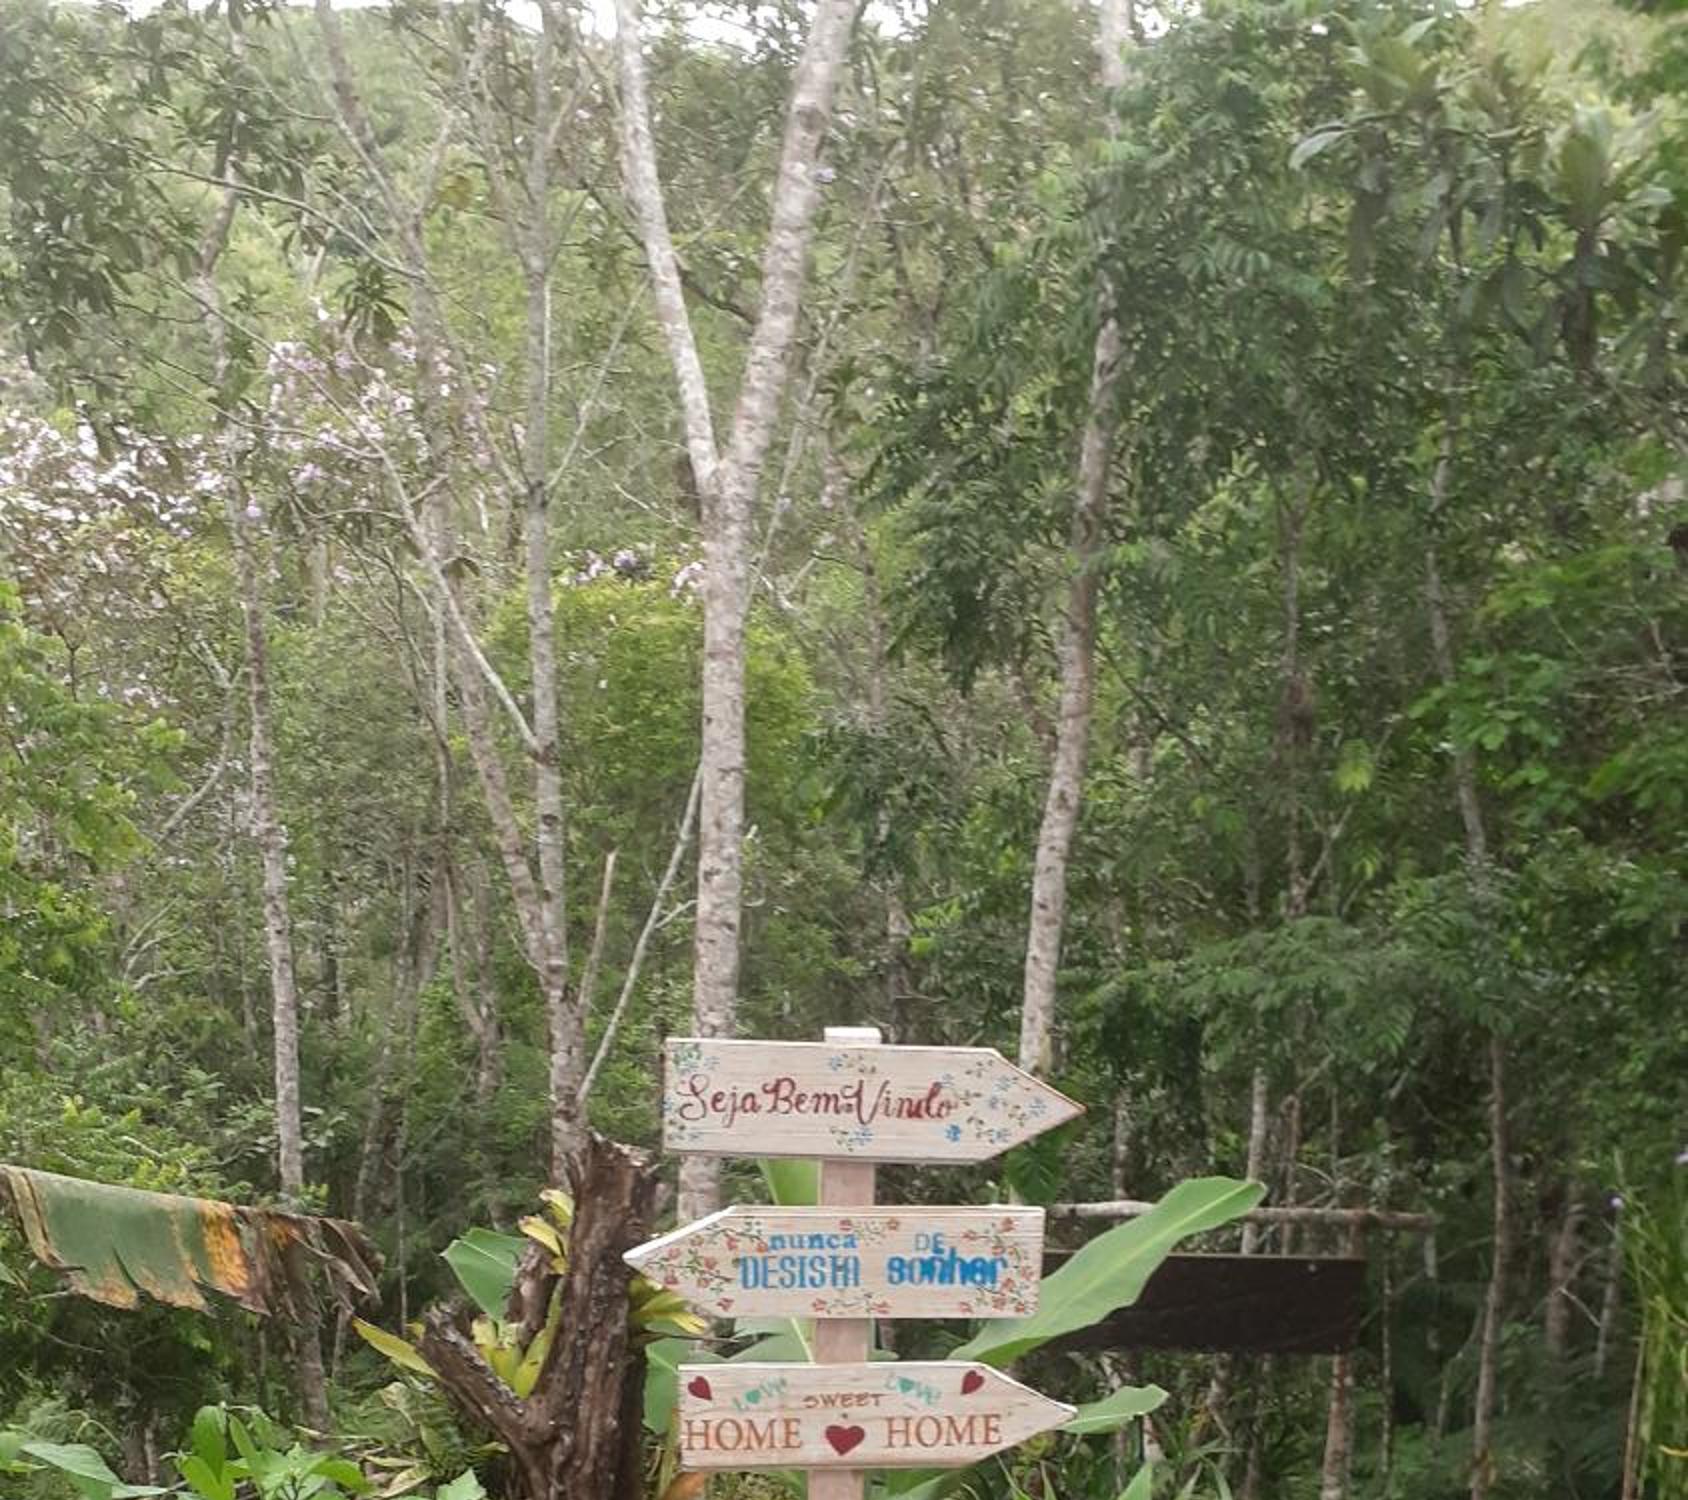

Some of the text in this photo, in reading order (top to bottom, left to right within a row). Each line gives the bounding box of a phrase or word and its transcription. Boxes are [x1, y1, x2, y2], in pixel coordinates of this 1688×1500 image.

[677, 1073, 761, 1128] Seja
[914, 1232, 945, 1254] DE
[802, 1393, 883, 1408] SWEET
[683, 1413, 1002, 1450] HOME HOME
